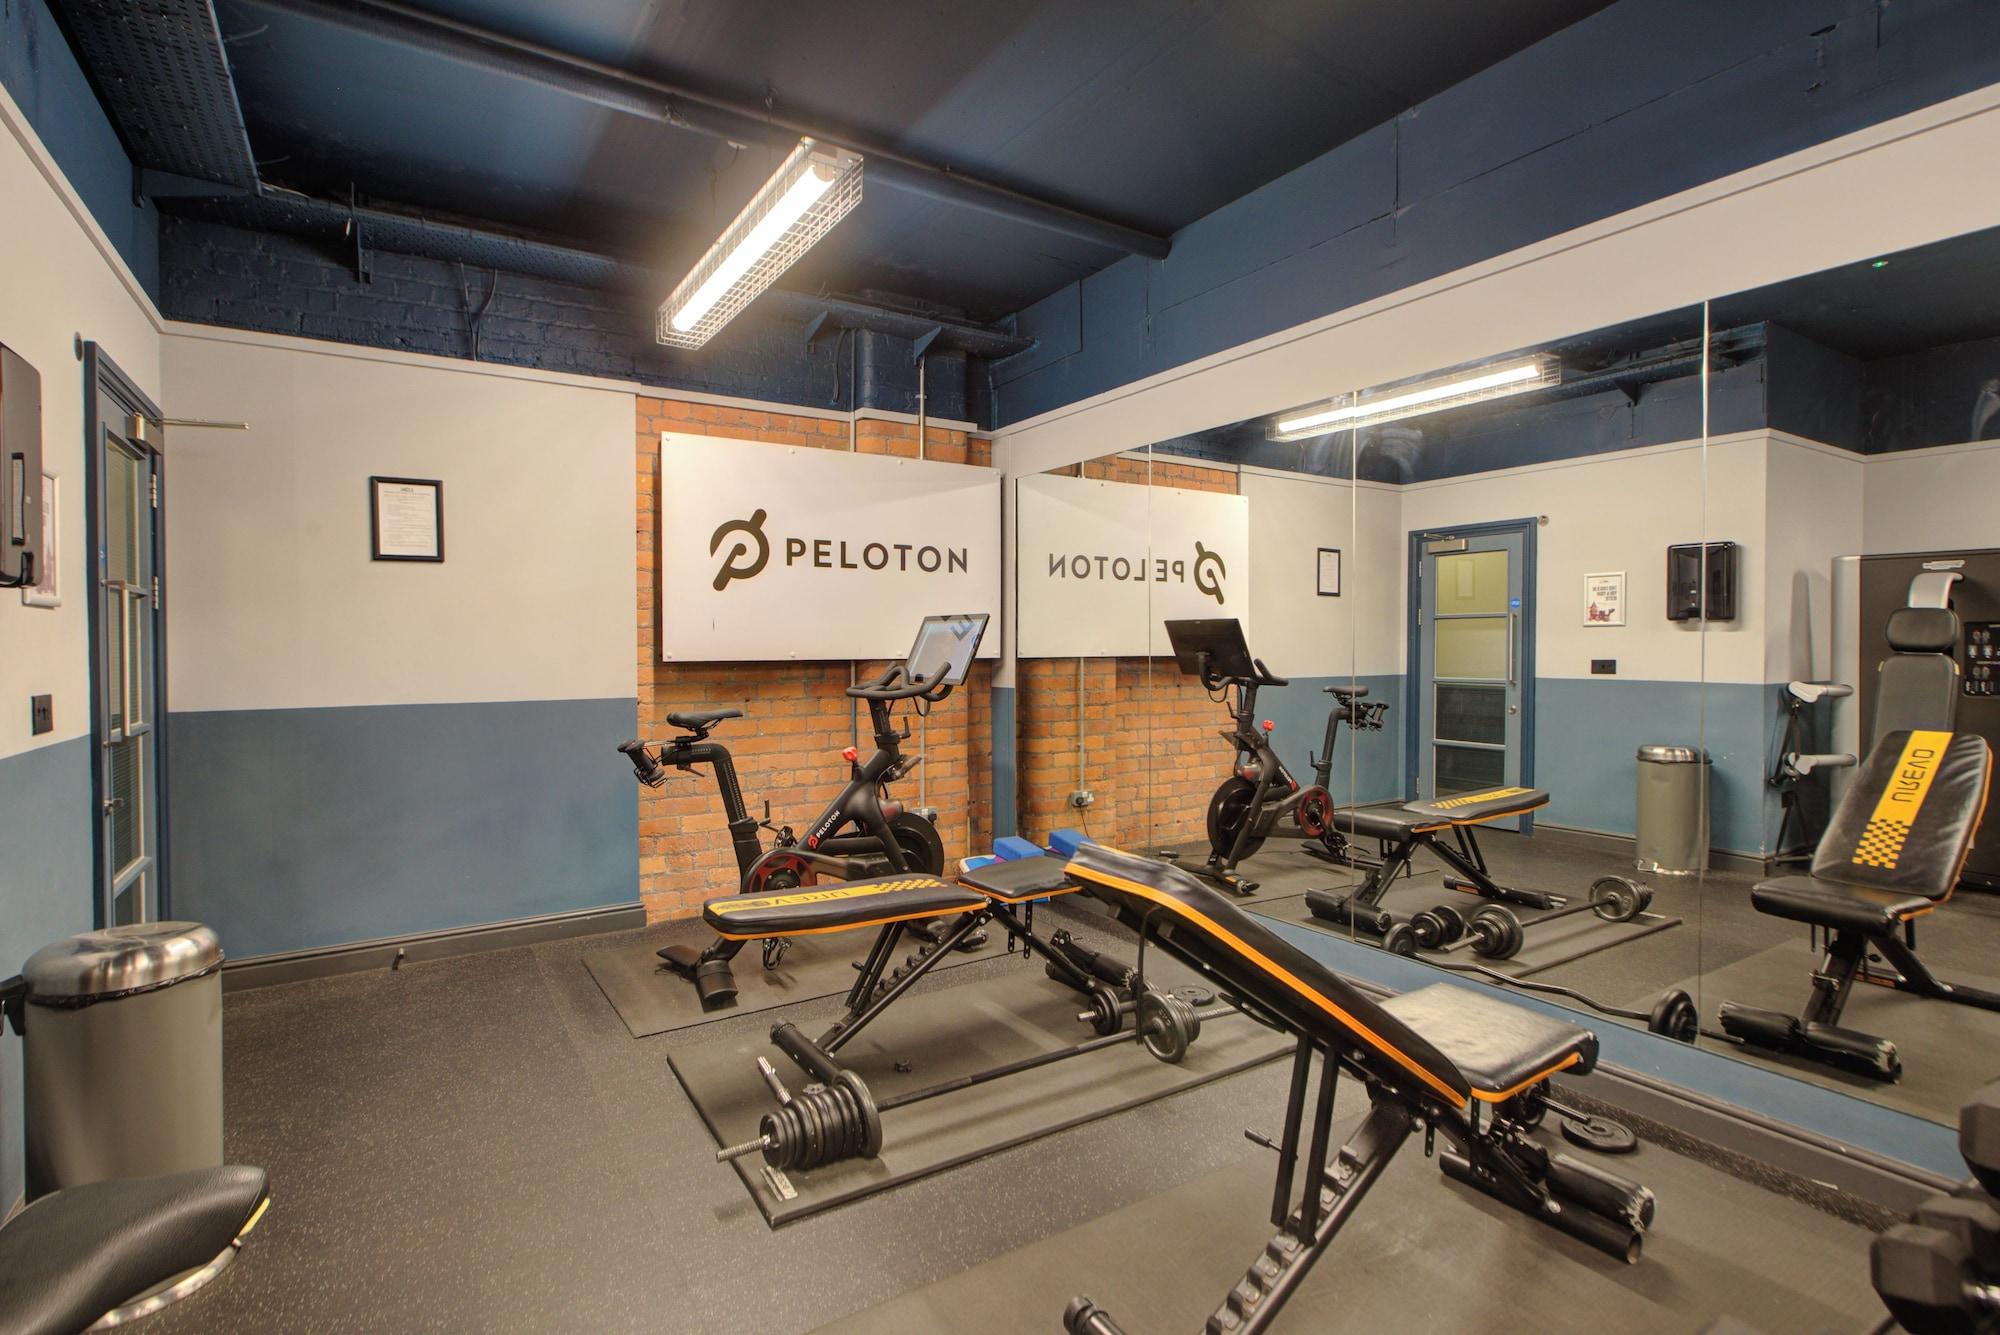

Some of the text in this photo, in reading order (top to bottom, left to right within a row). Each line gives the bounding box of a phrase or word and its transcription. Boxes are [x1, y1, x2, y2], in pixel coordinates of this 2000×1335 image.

[786, 537, 968, 574] PELOTON
[816, 810, 841, 838] PELOTON
[754, 890, 849, 908] UREVO
